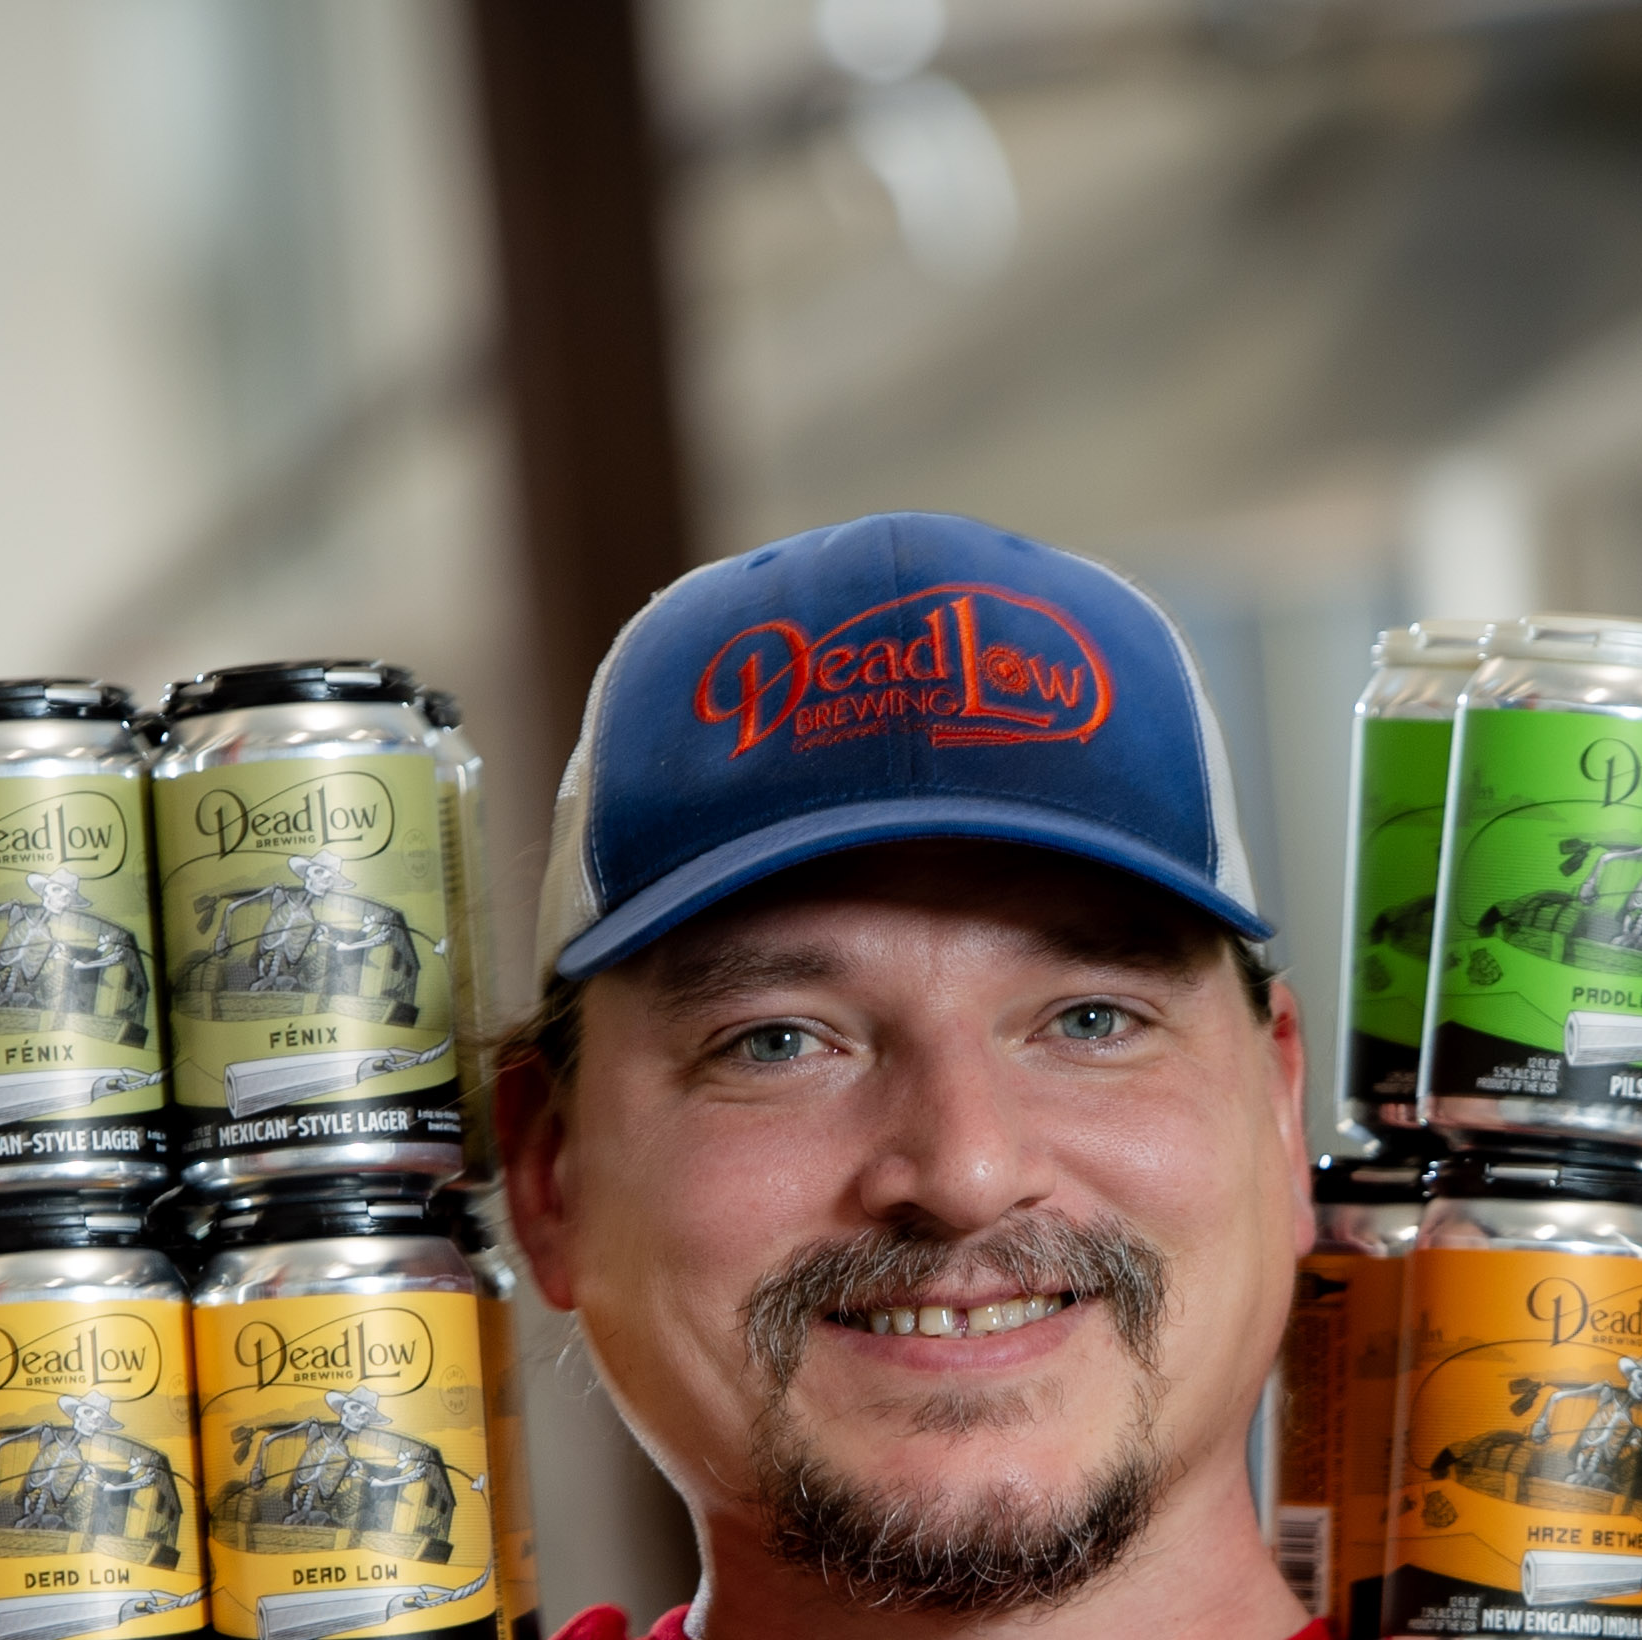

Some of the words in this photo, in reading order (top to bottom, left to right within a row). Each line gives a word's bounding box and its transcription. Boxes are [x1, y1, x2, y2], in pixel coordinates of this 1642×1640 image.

[693, 607, 948, 760] Dead
[951, 597, 1085, 728] Low
[794, 687, 959, 736] BREWING
[56, 793, 113, 864] Low
[195, 789, 314, 860] Dead
[317, 784, 378, 846] Low
[255, 834, 316, 848] BREWING
[269, 1022, 338, 1049] FÉNIX
[5, 1039, 74, 1064] FÉNIX
[92, 1130, 140, 1151] LAGER
[219, 1112, 353, 1147] MEXICAN-STYLE
[359, 1110, 408, 1133] LAGER
[1527, 1277, 1642, 1347] Dead
[84, 1326, 147, 1385] Low
[235, 1321, 350, 1392] Dead
[355, 1321, 416, 1380] Low
[25, 1374, 87, 1386] BREWING
[294, 1369, 354, 1382] BREWING
[1527, 1526, 1581, 1546] HAZE
[24, 1571, 78, 1588] DEAD
[89, 1568, 131, 1586] LOW
[293, 1566, 346, 1586] DEAD
[357, 1563, 398, 1582] LOW
[1482, 1608, 1523, 1631] NEW
[1524, 1611, 1601, 1635] ENGLAND
[1603, 1615, 1639, 1638] INDIA
